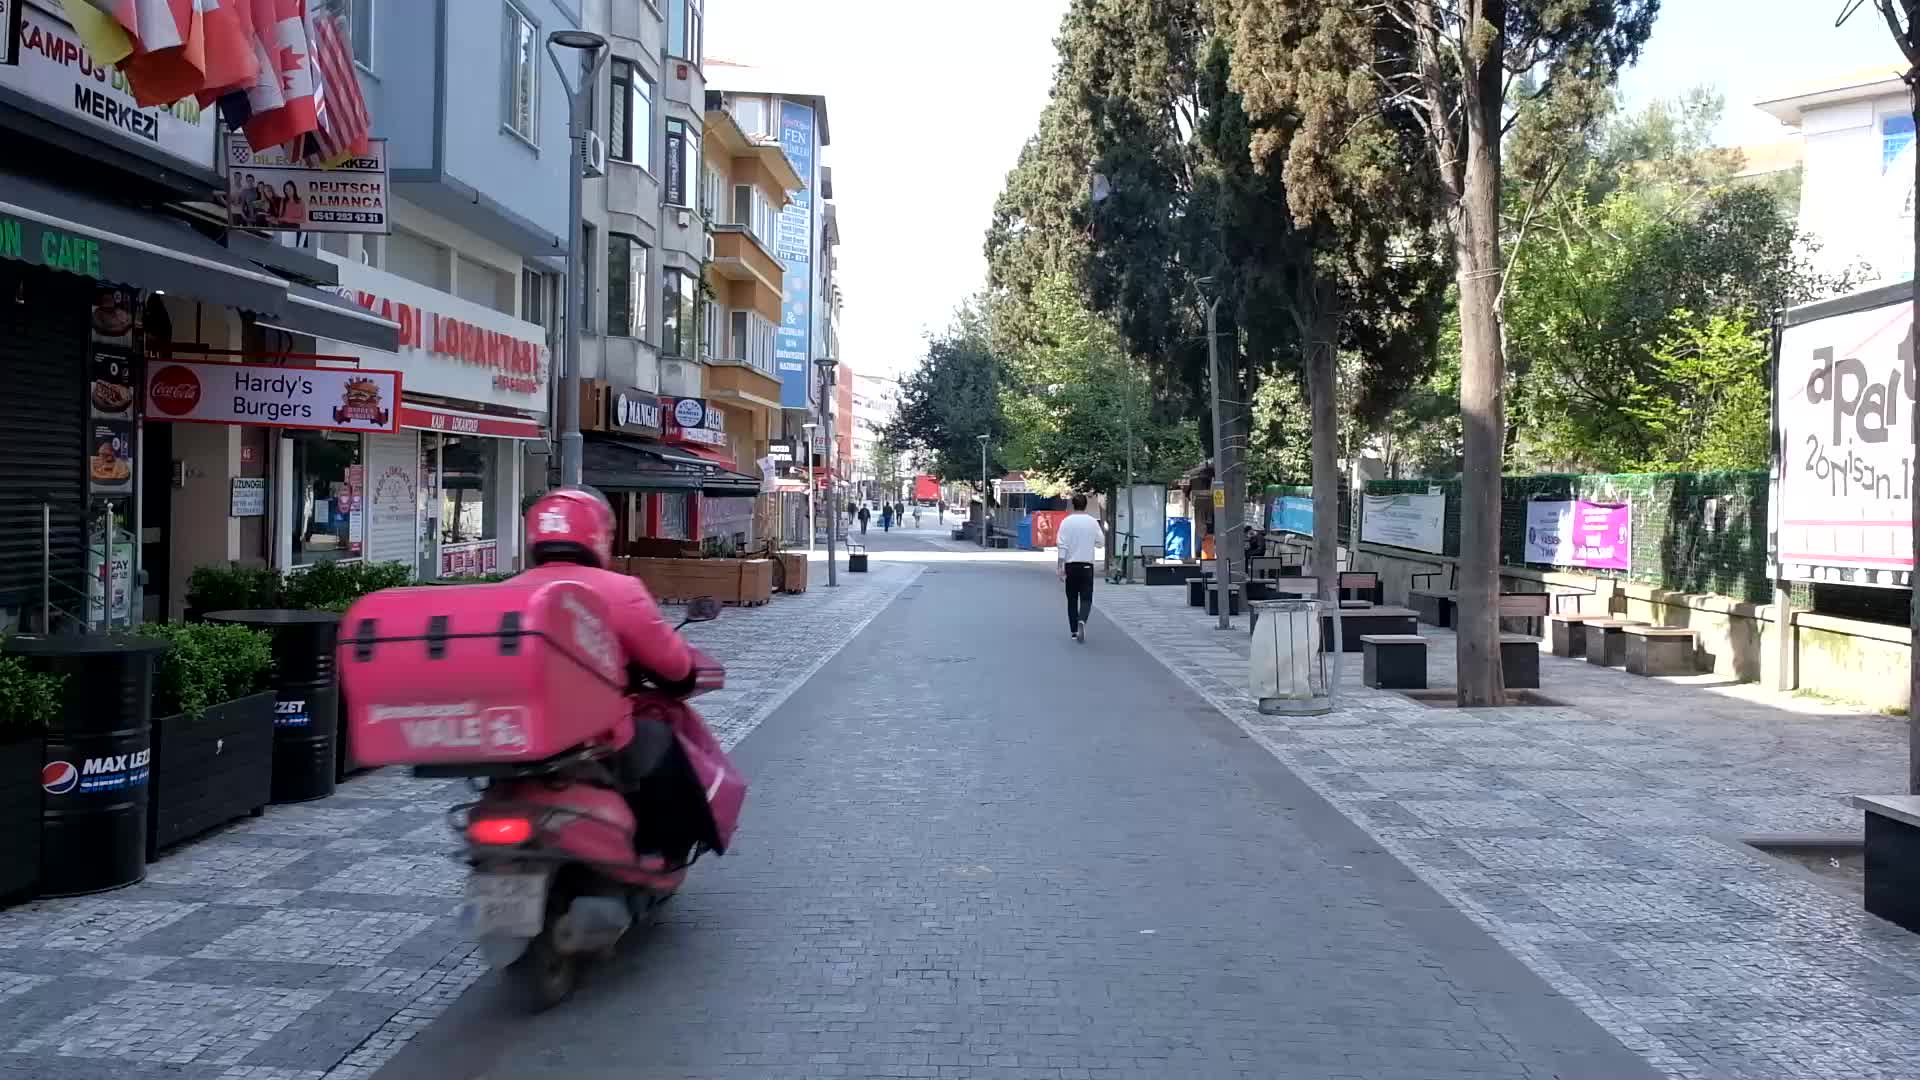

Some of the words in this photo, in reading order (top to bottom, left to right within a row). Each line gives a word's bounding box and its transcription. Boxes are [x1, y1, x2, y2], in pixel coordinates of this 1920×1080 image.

[75, 83, 158, 142] MERKEZİ
[784, 128, 806, 144] FEN
[309, 181, 381, 195] DEUTSCH
[309, 196, 383, 209] ALMANCA
[41, 231, 99, 276] CAFE
[235, 372, 313, 399] Hardy's
[233, 396, 312, 421] Burgers
[629, 400, 659, 429] MANGAL
[82, 757, 128, 776] MAX
